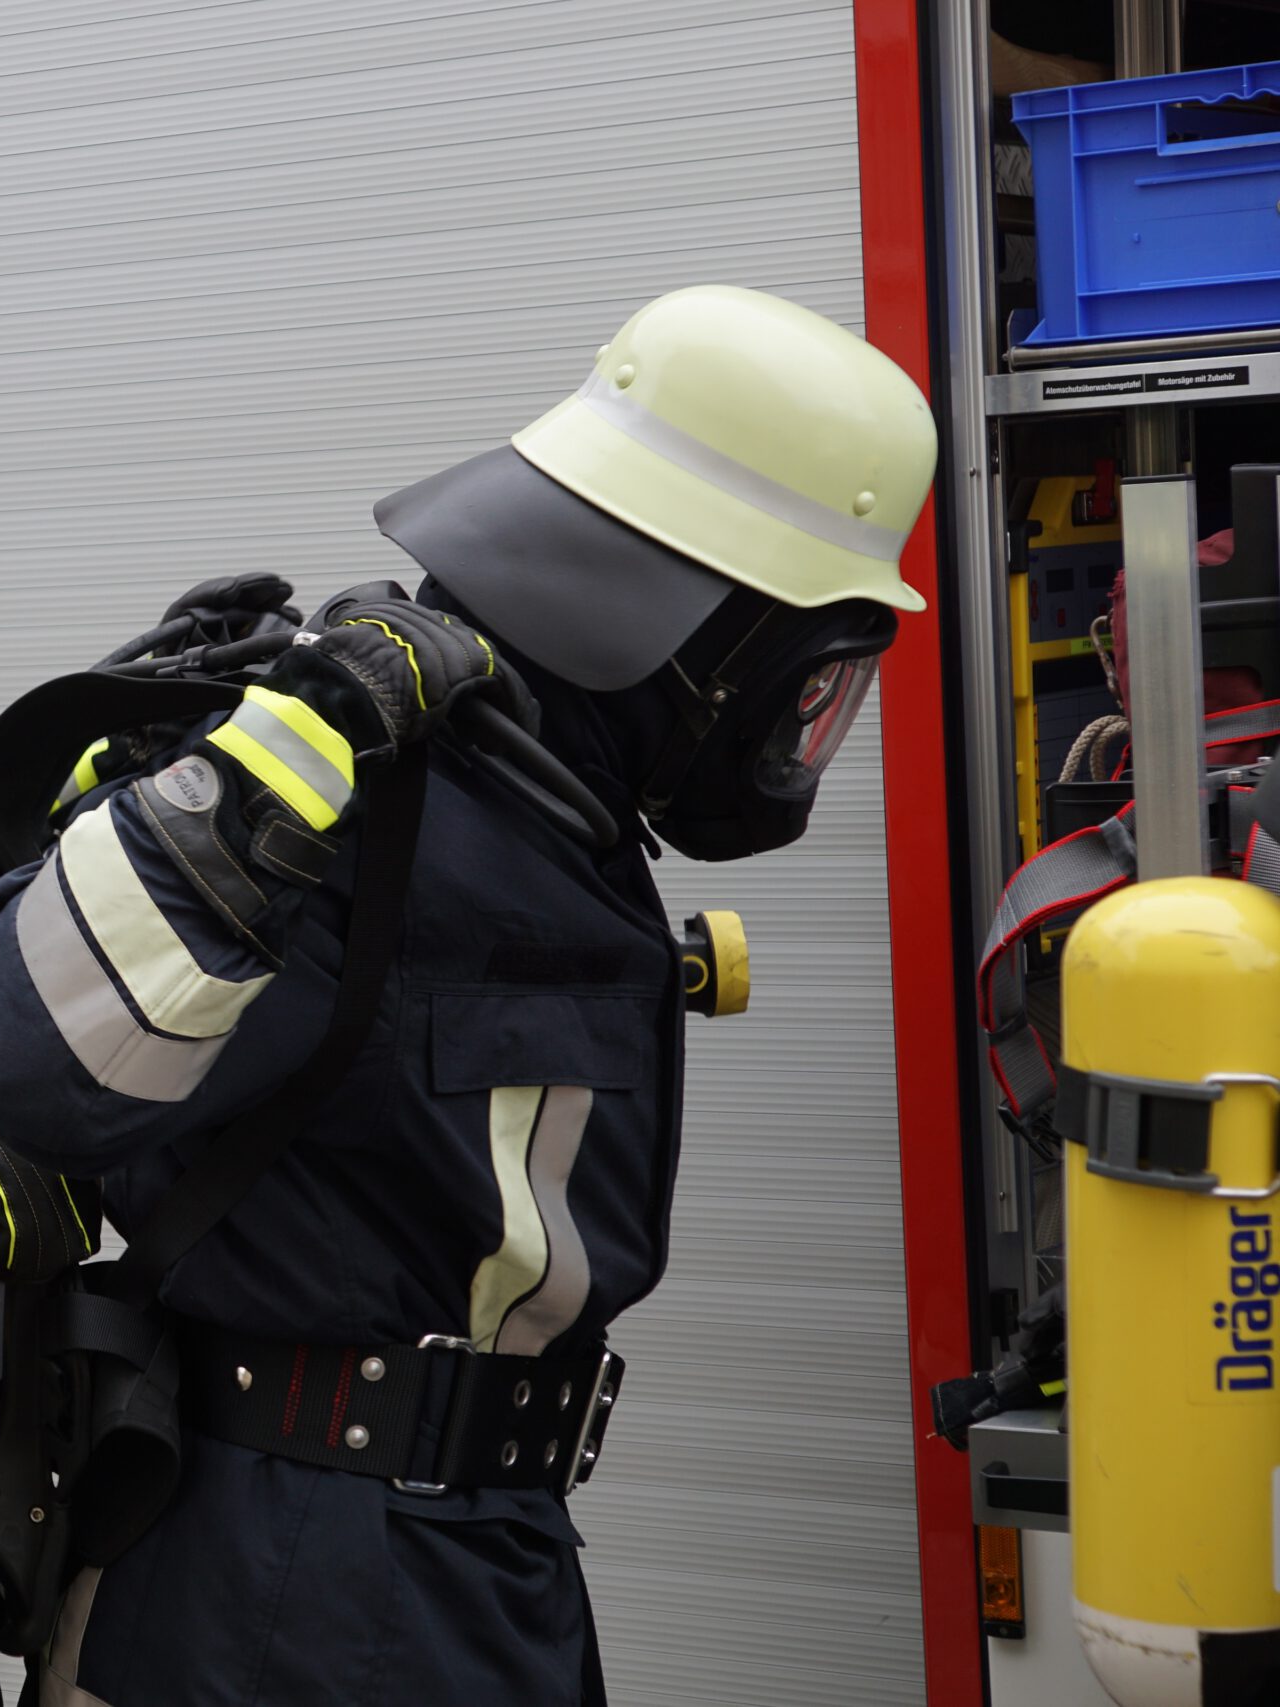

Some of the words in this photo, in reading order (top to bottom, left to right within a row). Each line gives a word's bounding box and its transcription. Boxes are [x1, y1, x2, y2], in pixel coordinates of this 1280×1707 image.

[1157, 374, 1194, 387] Motorsäge
[1195, 373, 1207, 383] mit
[1207, 372, 1236, 382] Zubehör
[1214, 1206, 1280, 1391] Dräger
